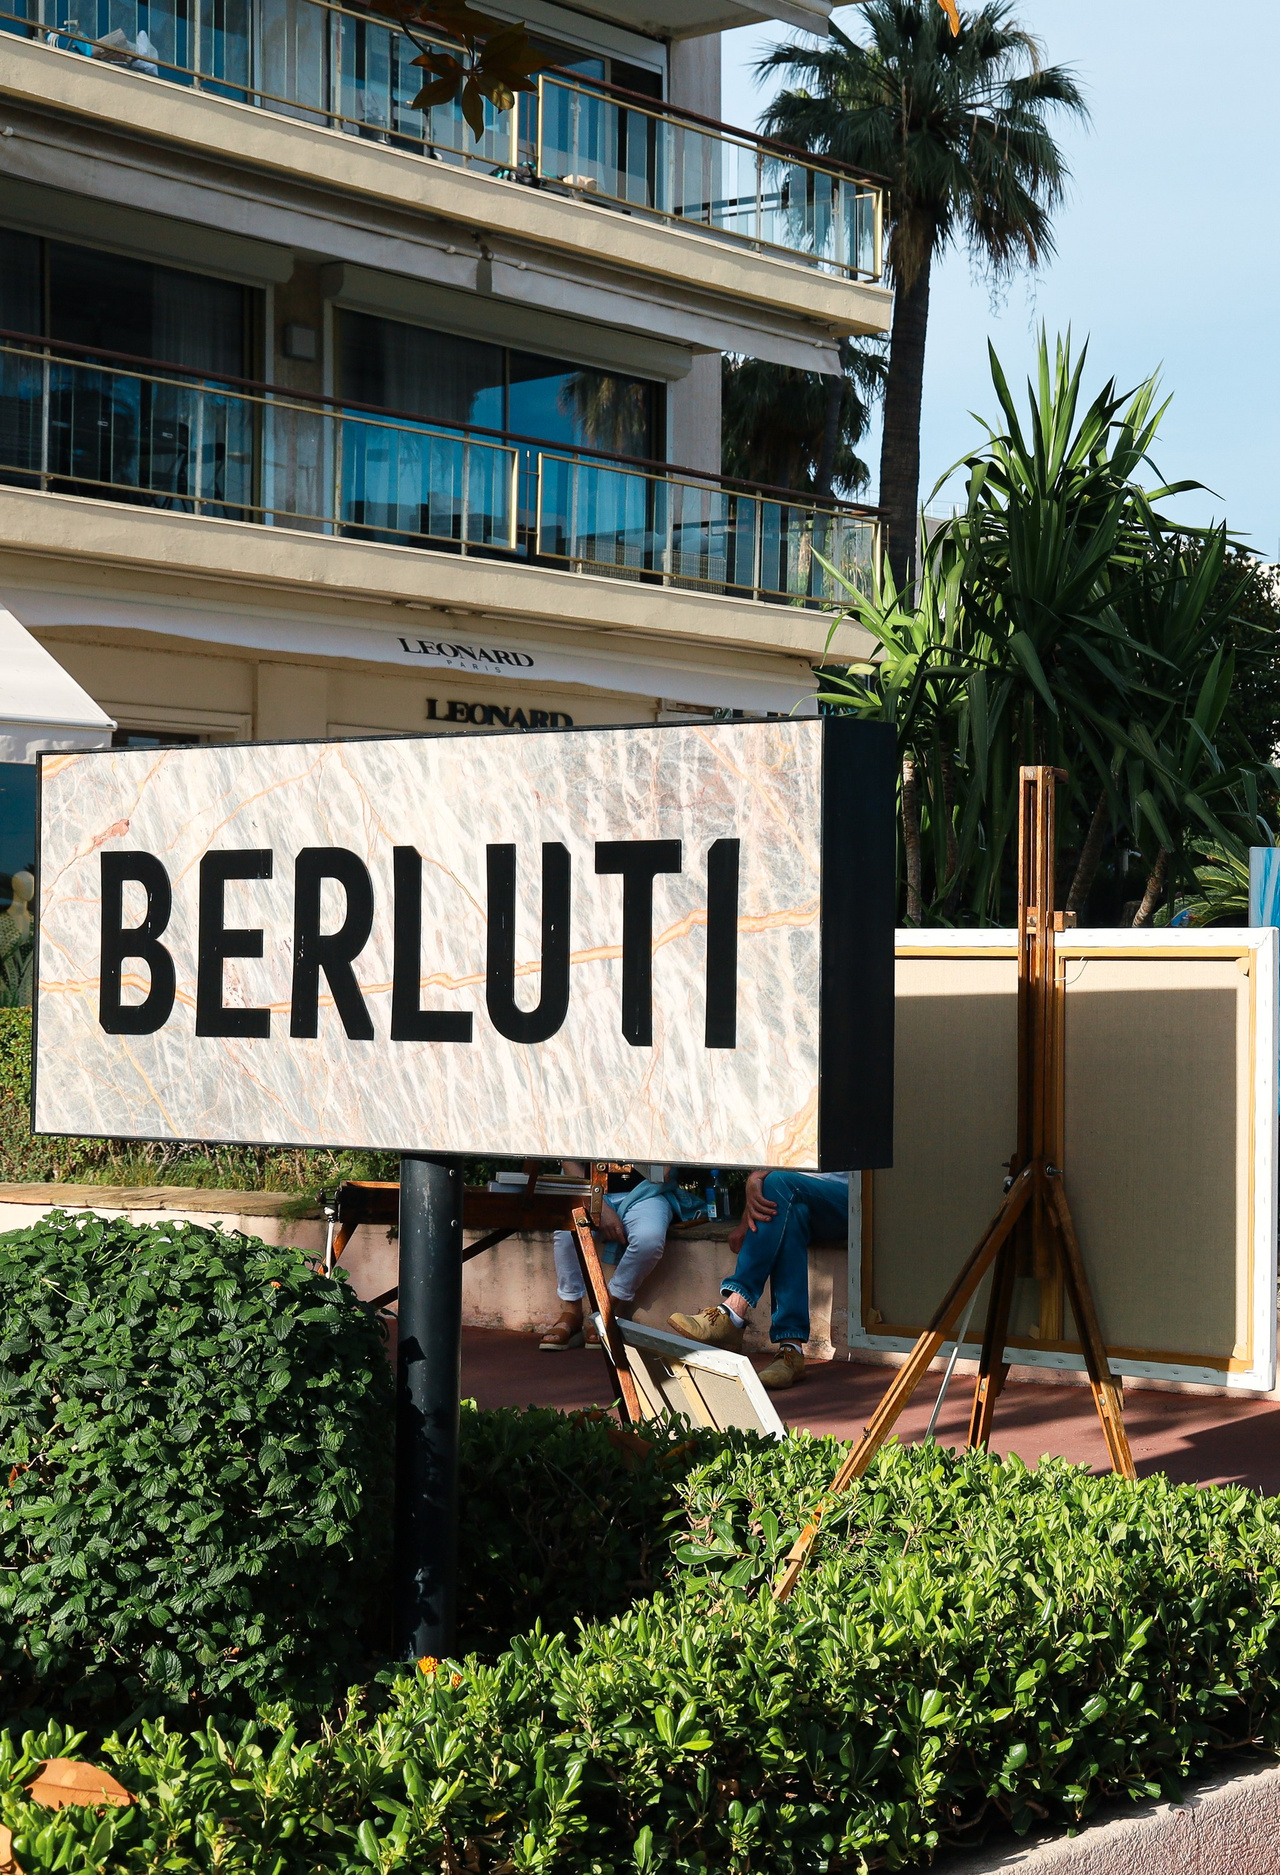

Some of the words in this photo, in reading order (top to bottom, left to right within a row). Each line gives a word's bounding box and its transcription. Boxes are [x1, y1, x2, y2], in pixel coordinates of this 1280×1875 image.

[397, 637, 535, 668] LEONARD
[447, 659, 502, 674] PARIS
[426, 698, 574, 729] LEONARD
[99, 837, 741, 1050] BERLUTI
